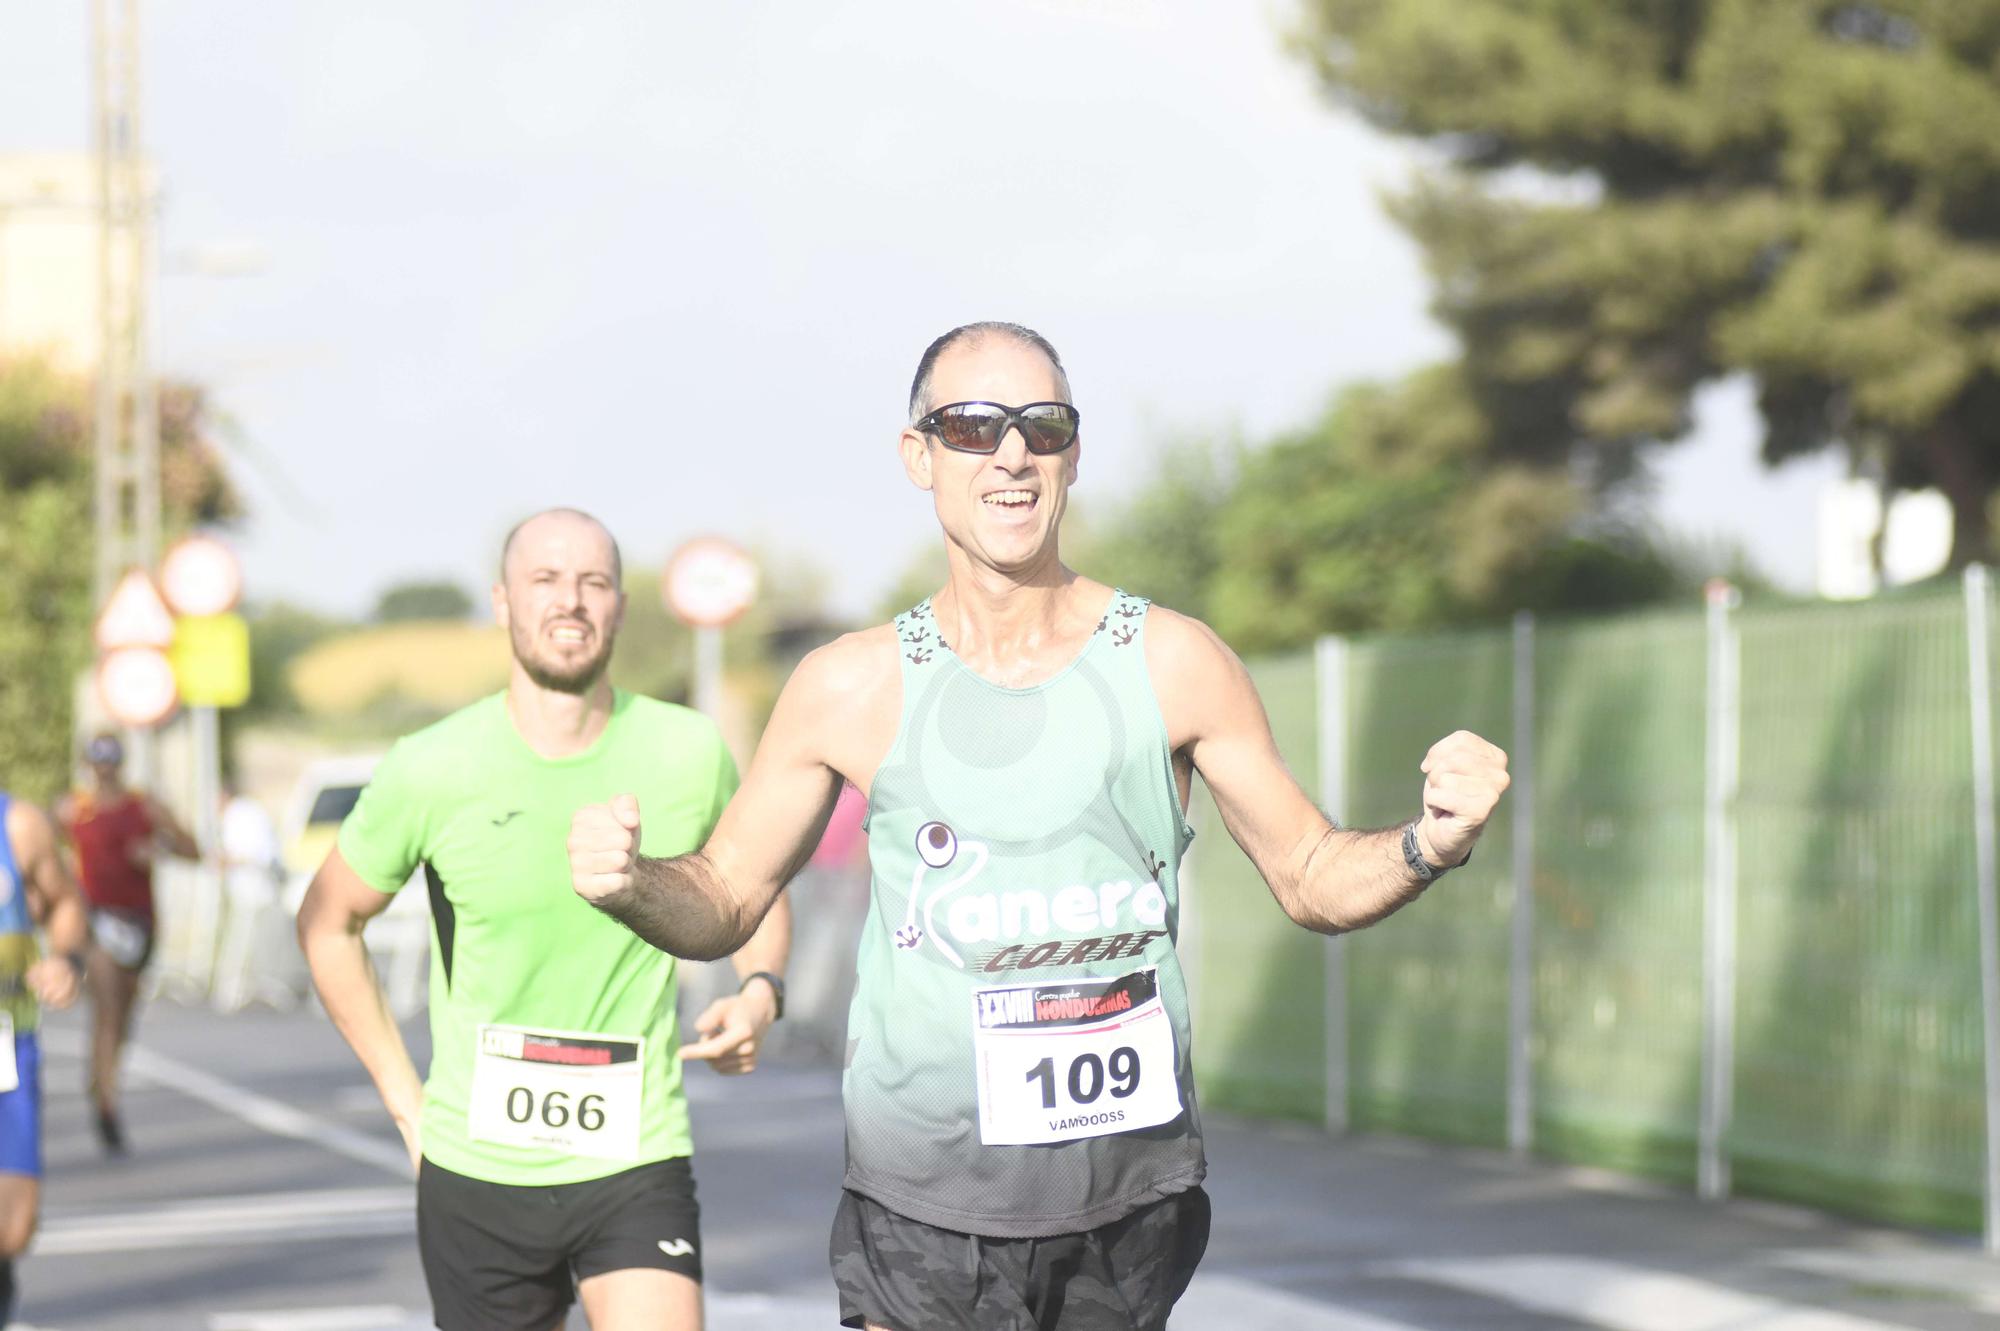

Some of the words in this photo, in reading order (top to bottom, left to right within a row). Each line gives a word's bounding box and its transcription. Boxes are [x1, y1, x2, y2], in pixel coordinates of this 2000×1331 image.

[980, 930, 1167, 973] CORRE
[1026, 1046, 1141, 1109] 109
[506, 1087, 606, 1131] 066
